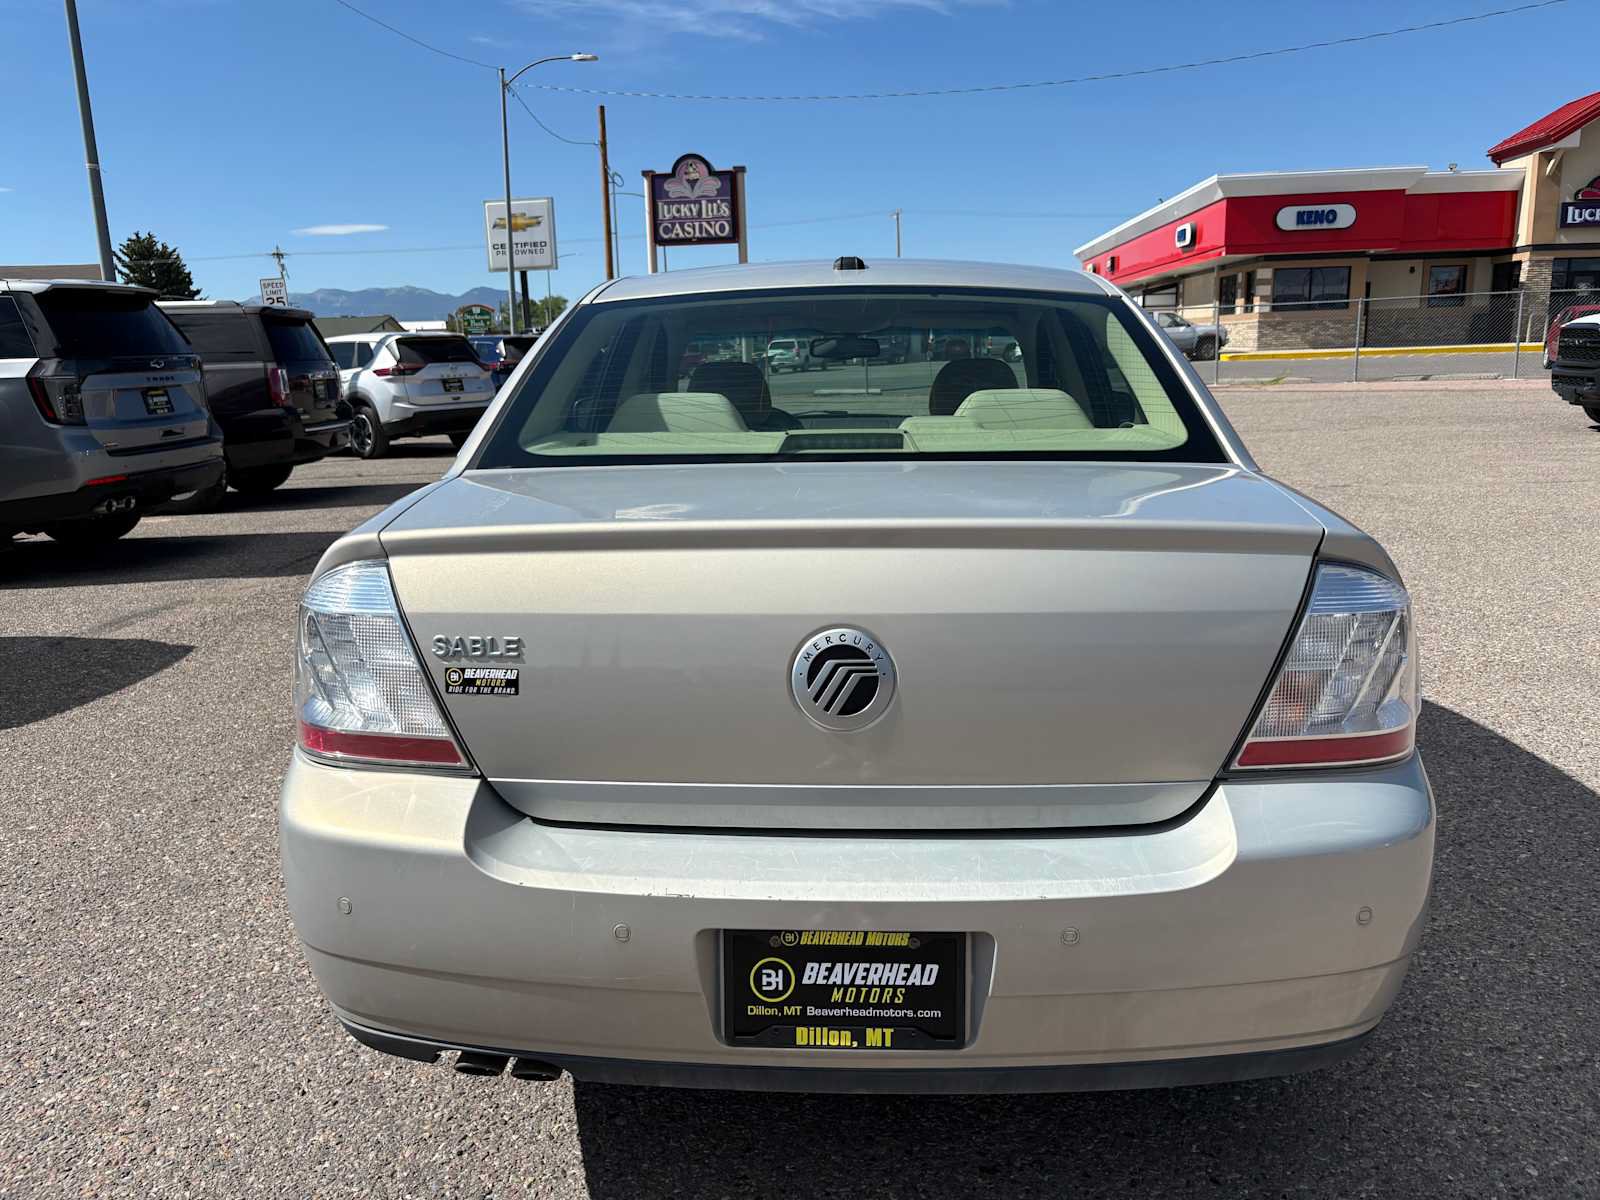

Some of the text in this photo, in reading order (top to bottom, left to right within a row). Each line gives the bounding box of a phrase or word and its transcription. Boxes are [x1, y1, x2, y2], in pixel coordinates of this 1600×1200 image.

[658, 202, 699, 219] LUCKY
[1296, 209, 1338, 226] KENO
[659, 221, 729, 238] CASINO
[492, 241, 547, 250] CETIFIED
[431, 634, 522, 658] SABLE
[803, 633, 884, 662] MERCURY
[463, 668, 518, 680] BEAVERHEAD
[475, 679, 506, 687] MOTORS
[799, 931, 864, 946] BEAVERHEAD
[865, 932, 910, 946] MOTORS
[801, 962, 940, 986] BEAVERHEAD
[830, 987, 906, 1004] MOTORS
[747, 1005, 942, 1019] Dillon, MT Beaverheadmotors.com
[795, 1027, 895, 1048] Dillon, MT
